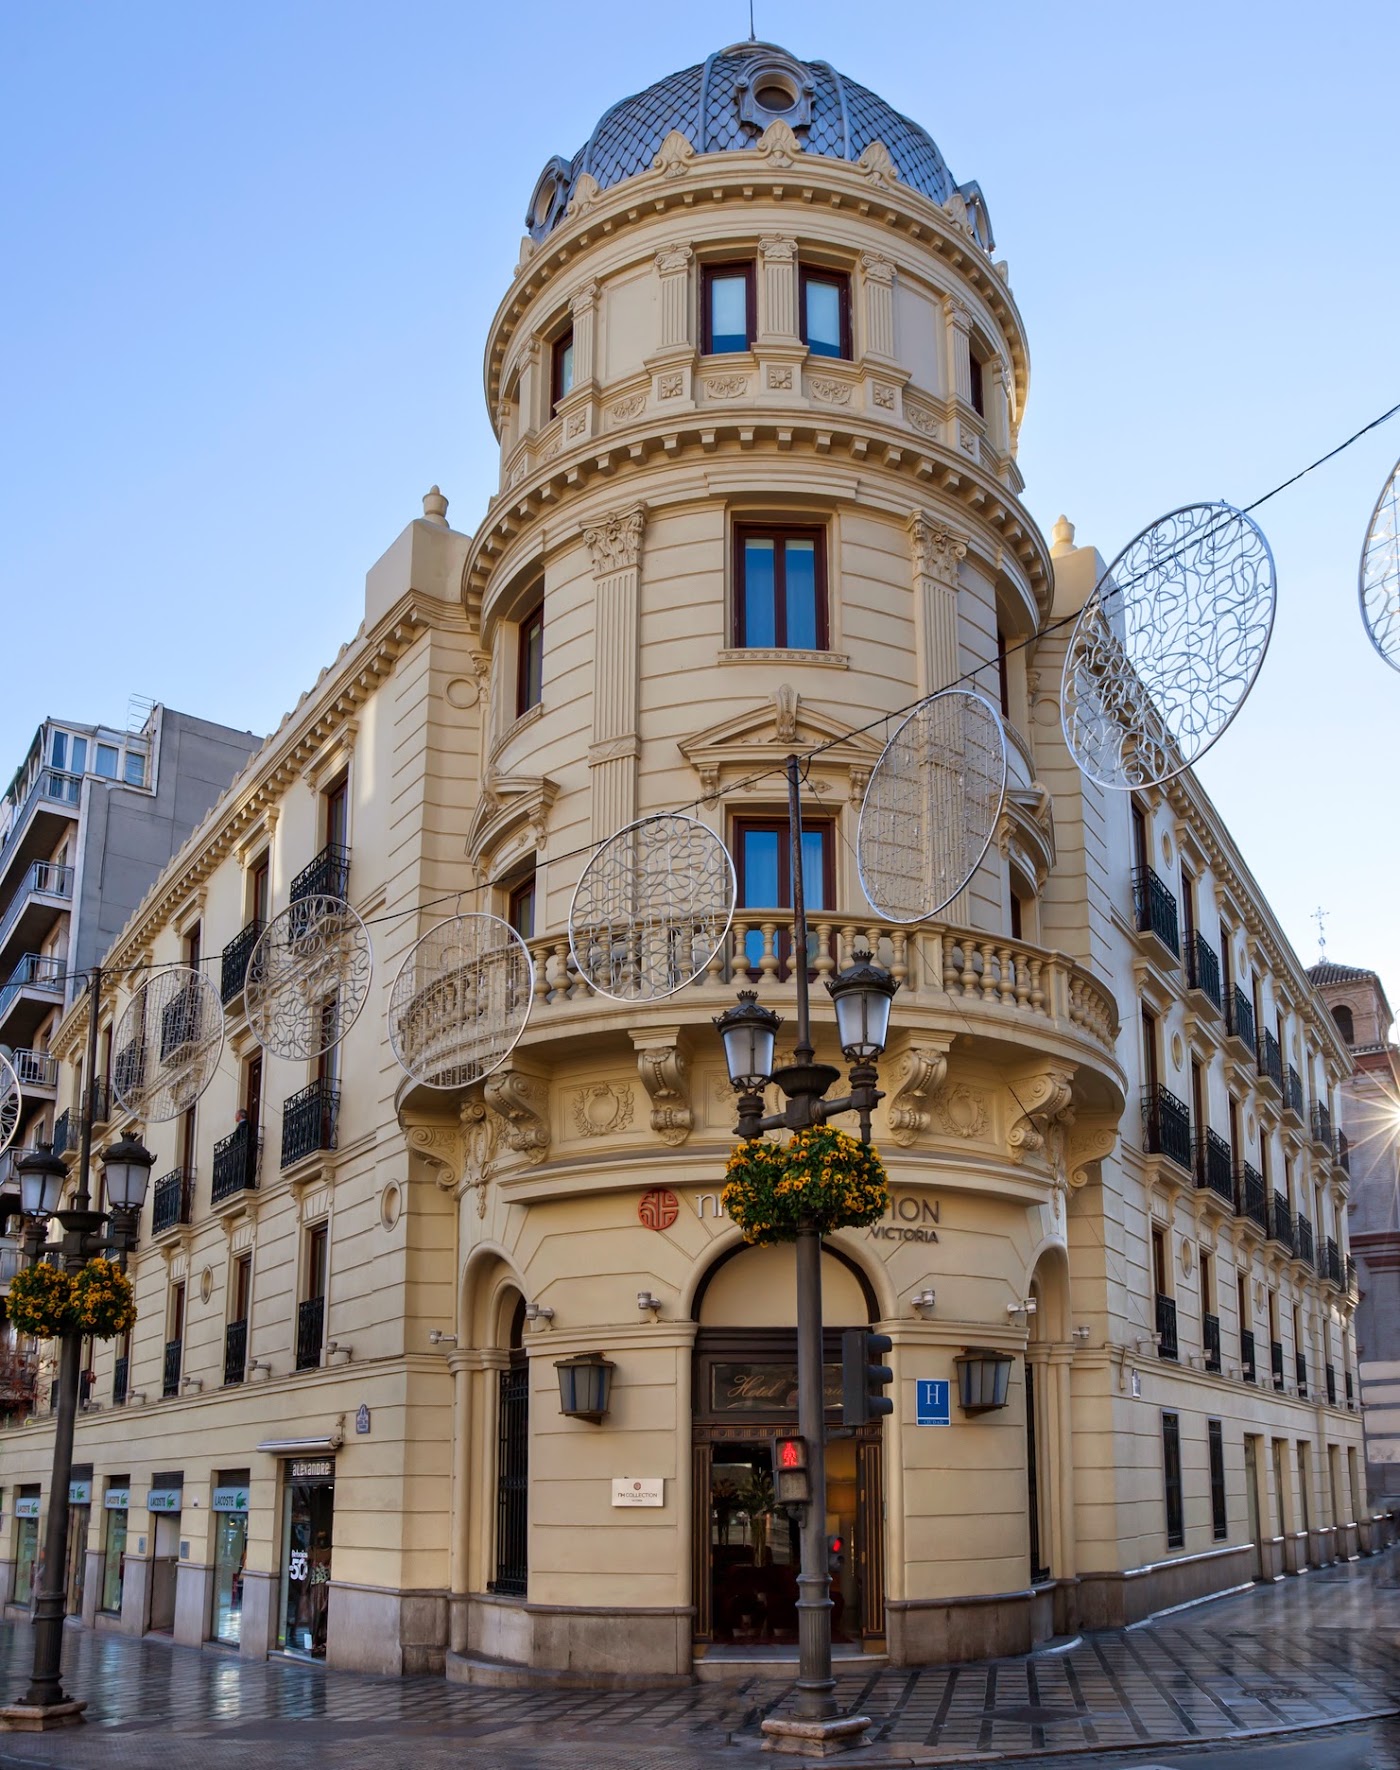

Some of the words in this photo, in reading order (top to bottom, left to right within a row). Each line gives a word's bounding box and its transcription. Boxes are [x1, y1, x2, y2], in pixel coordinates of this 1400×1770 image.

[870, 1226, 939, 1243] VICTORIA
[727, 1375, 786, 1398] Hotel
[925, 1384, 941, 1405] H
[150, 1497, 166, 1507] LACOSTE
[215, 1495, 234, 1506] LACOSTE
